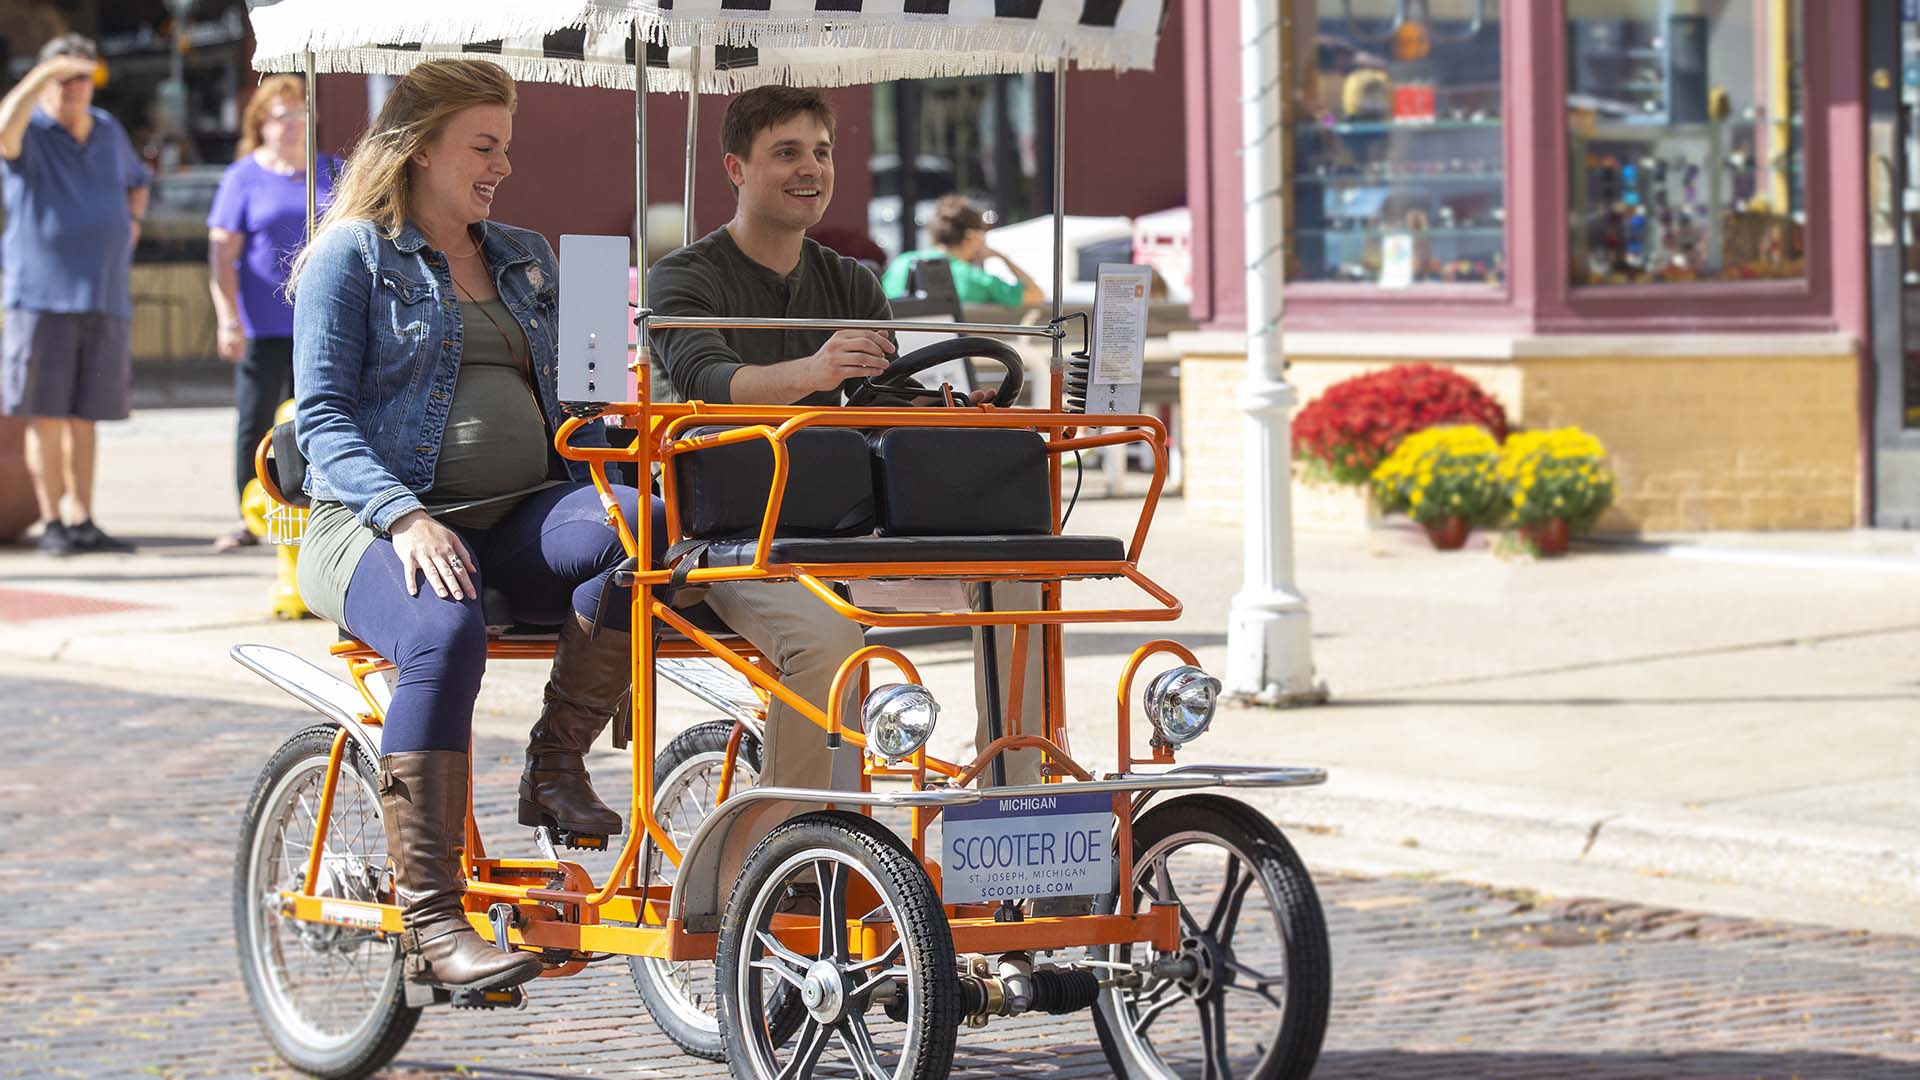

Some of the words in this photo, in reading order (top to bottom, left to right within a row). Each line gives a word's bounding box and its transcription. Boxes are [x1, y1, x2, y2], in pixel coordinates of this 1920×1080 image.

[999, 797, 1057, 811] MICHIGAN
[952, 833, 1056, 871] SCOOTER
[1062, 830, 1102, 864] JOE
[969, 874, 983, 884] ST.
[987, 872, 1028, 882] JOSEPH,
[1032, 867, 1087, 879] MICHIGAN
[981, 882, 1074, 897] SCOOTJOE.COM
